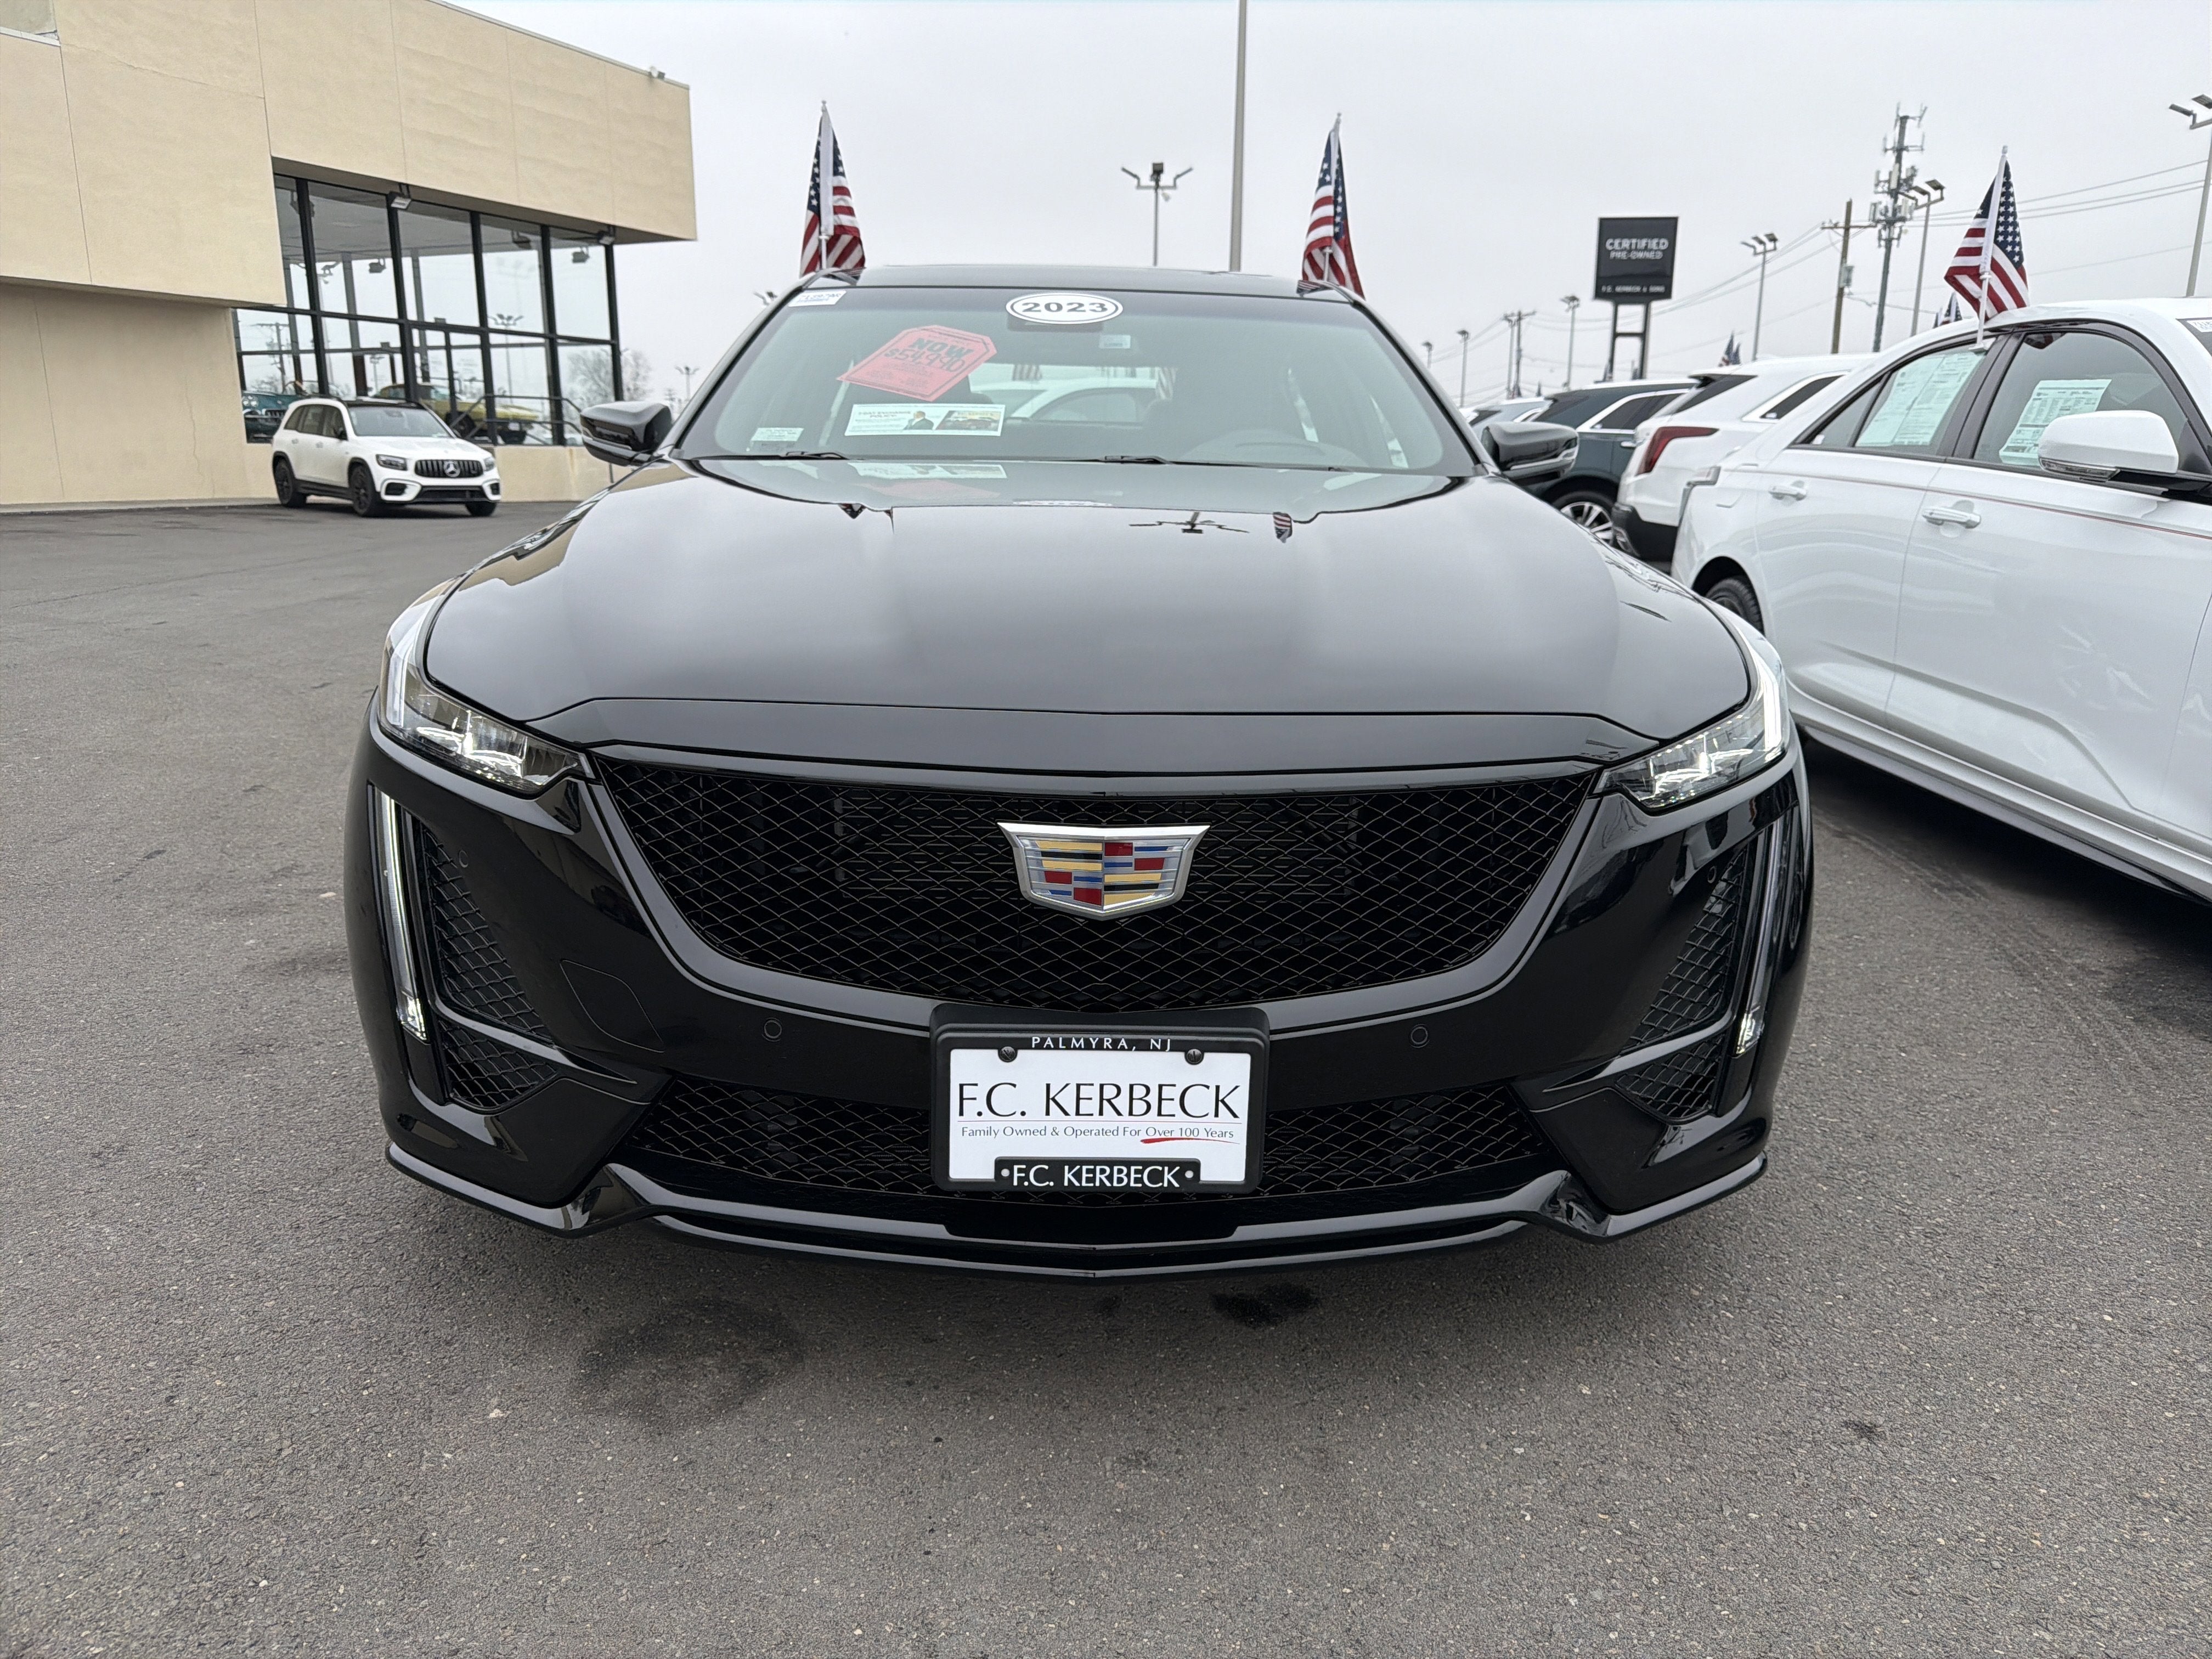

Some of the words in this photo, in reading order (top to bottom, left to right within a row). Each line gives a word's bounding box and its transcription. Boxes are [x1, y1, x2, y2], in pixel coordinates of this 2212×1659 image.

[1605, 238, 1669, 250] CERTIFIED
[1022, 302, 1108, 313] 2023
[908, 337, 975, 359] NOW
[1031, 1036, 1136, 1051] PALMYRA,
[1150, 1038, 1171, 1052] NJ
[959, 1082, 1026, 1117] F.C.
[1045, 1083, 1241, 1119] KERBECK
[962, 1126, 999, 1138] Family
[1003, 1125, 1047, 1136] Owned
[1051, 1126, 1059, 1136] &
[1064, 1125, 1119, 1138] Operated
[1123, 1127, 1141, 1136] For
[1146, 1127, 1175, 1137] Over
[1178, 1127, 1199, 1137] 100
[1204, 1127, 1234, 1138] Years
[1013, 1165, 1054, 1187] F.C.
[1064, 1165, 1180, 1187] KERBECK
